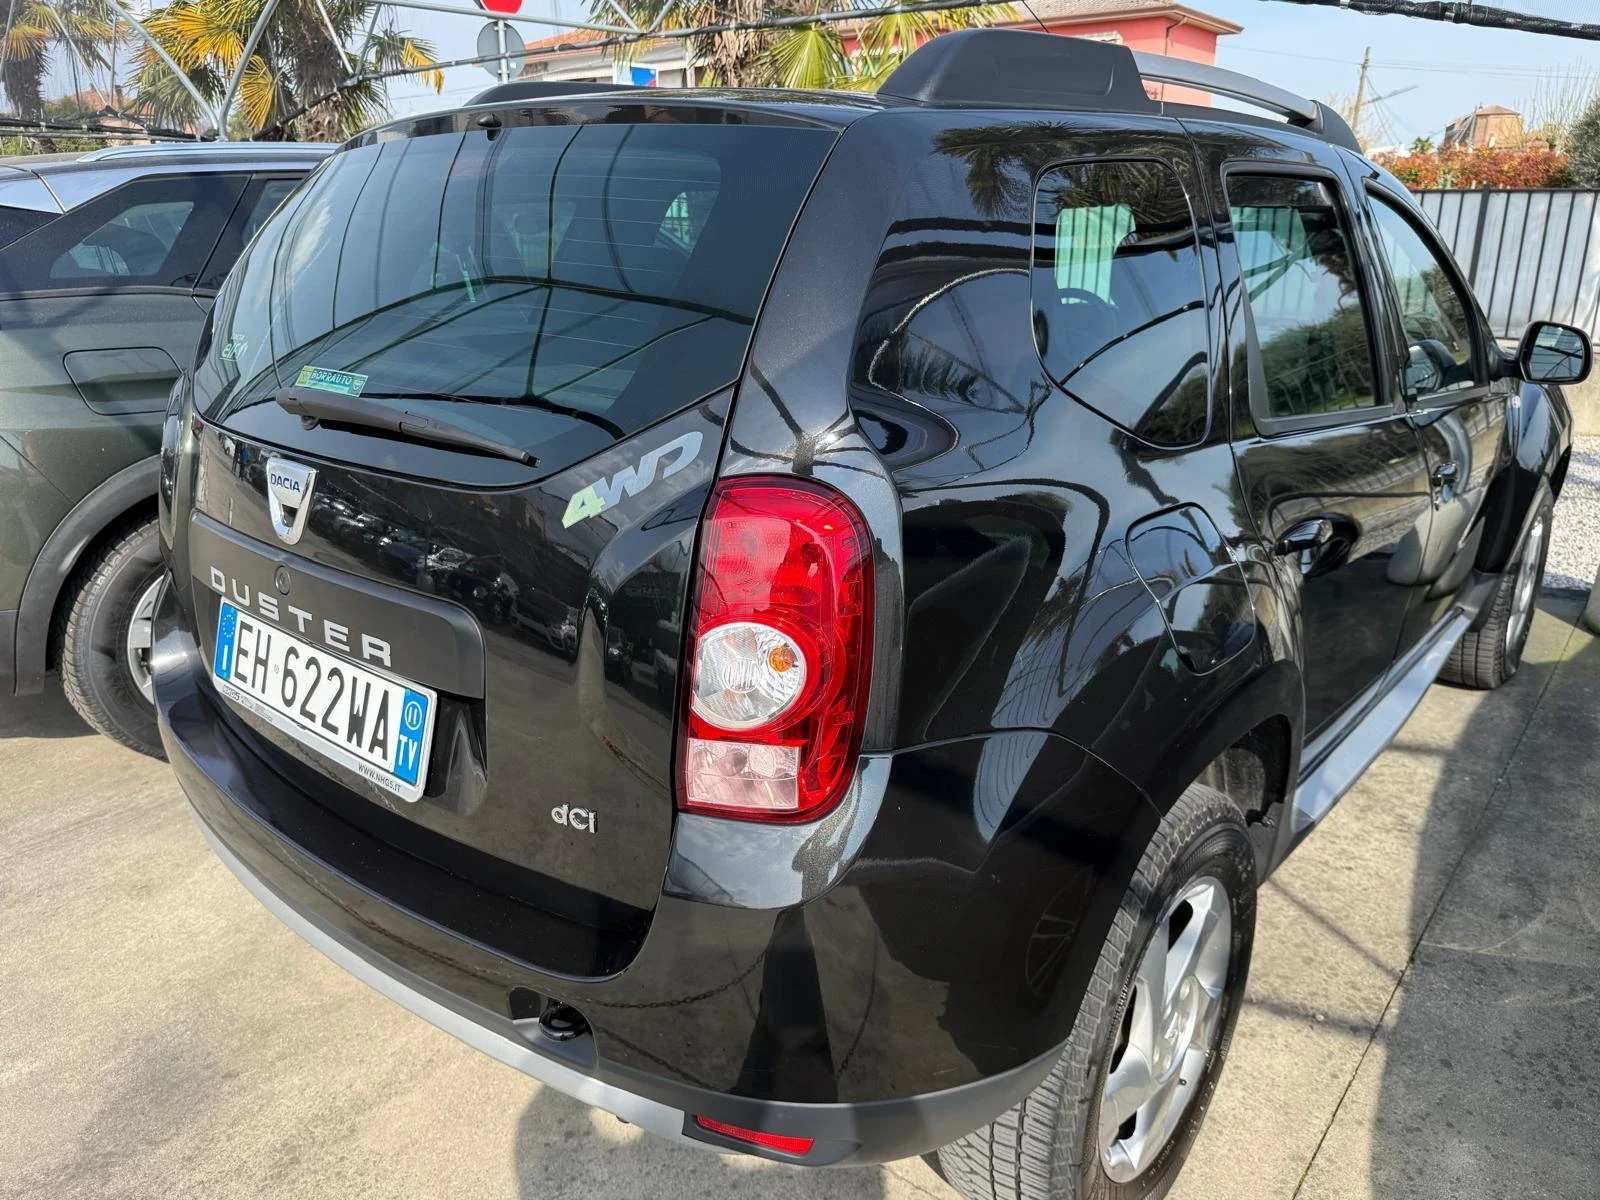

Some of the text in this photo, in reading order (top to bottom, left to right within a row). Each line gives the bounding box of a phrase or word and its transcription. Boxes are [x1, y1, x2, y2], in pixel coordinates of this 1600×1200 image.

[311, 370, 353, 385] BORRAUTO
[270, 473, 300, 492] DACIA
[562, 431, 703, 529] 4WD
[210, 566, 391, 667] DUSTER
[398, 734, 418, 771] TV
